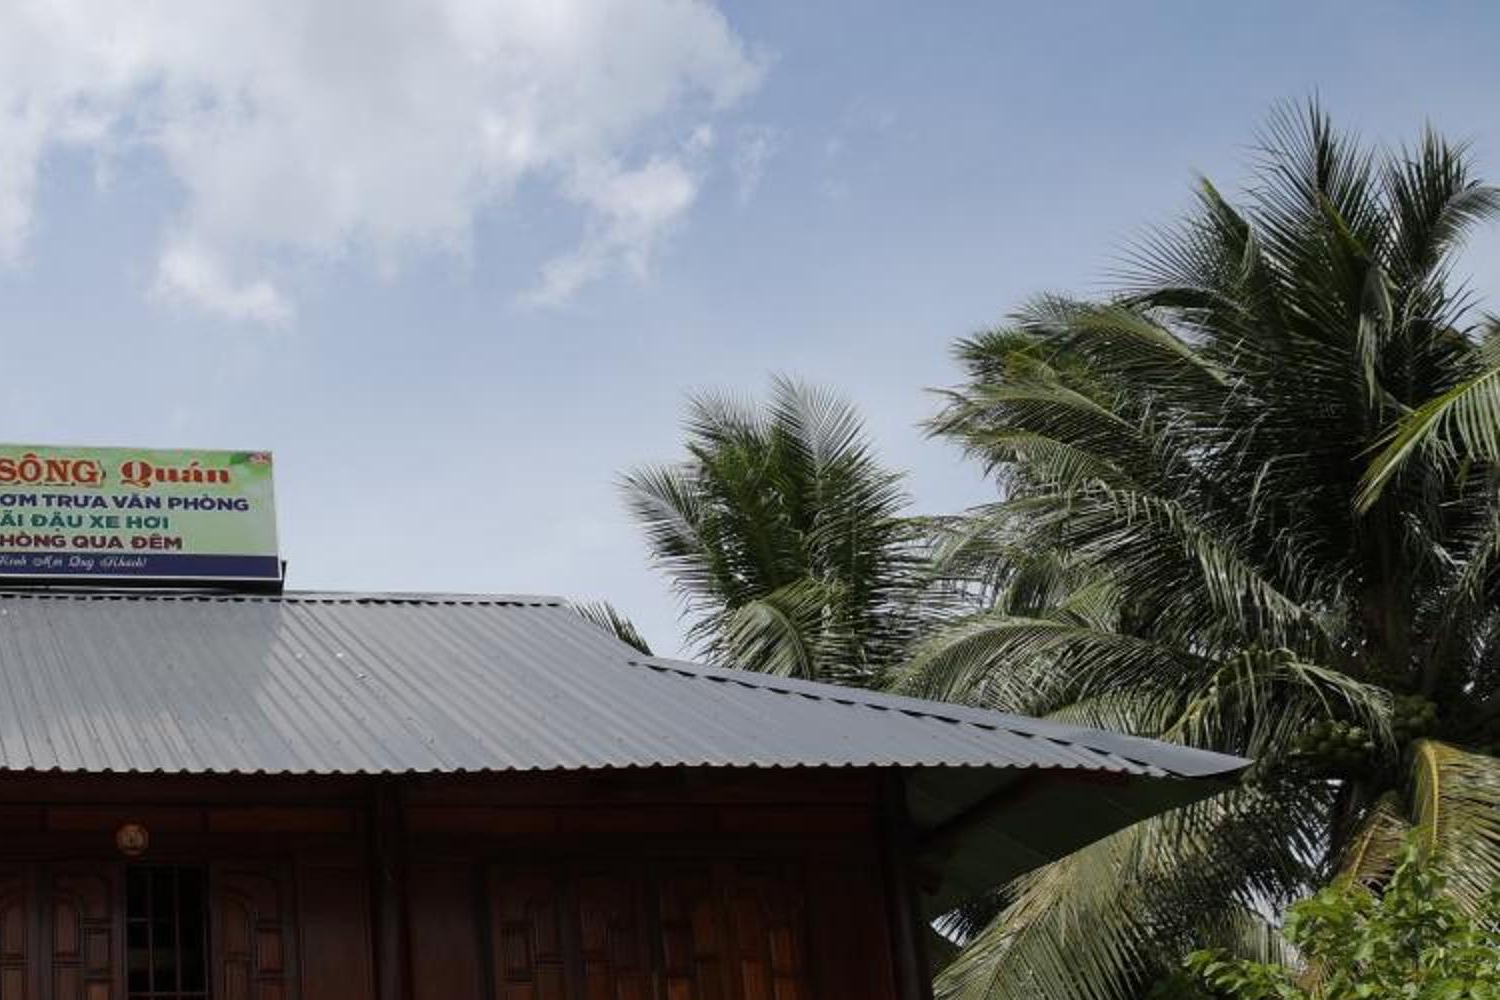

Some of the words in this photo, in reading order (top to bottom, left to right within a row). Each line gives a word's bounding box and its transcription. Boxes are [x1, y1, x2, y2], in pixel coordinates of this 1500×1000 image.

[120, 461, 230, 488] Quán
[41, 494, 109, 509] TRƯA
[111, 493, 162, 509] VĂN
[167, 493, 250, 512] PHÒNG
[89, 515, 120, 529] XE
[126, 515, 169, 530] HƠI
[72, 535, 124, 549] QUA
[131, 534, 183, 550] ĐÊM
